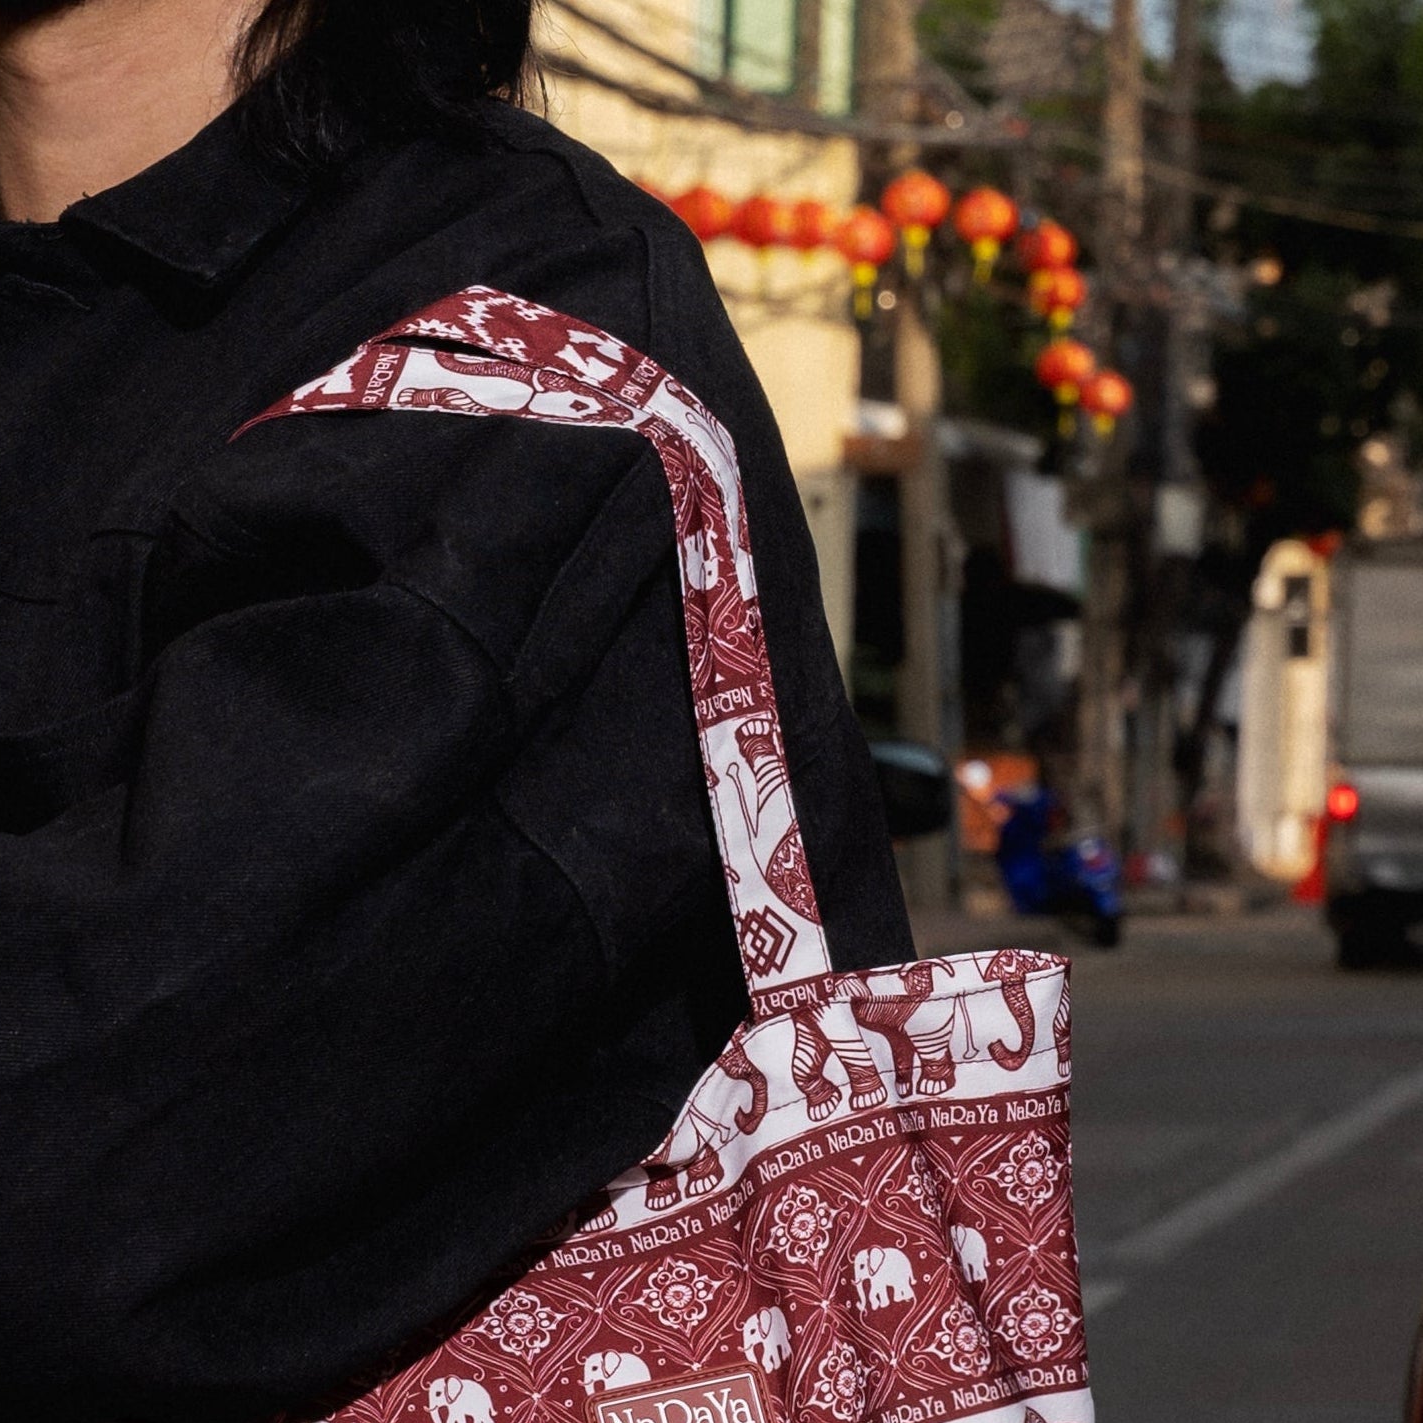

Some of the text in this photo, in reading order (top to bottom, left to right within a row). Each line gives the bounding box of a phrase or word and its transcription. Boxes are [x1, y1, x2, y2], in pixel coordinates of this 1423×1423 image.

[362, 353, 400, 404] NaRaYa
[551, 1240, 624, 1268] NaRaYa
[629, 1217, 703, 1253] NaRaYa
[707, 1183, 755, 1226] NaRaYa
[757, 1141, 823, 1184] NaRaYa
[826, 1118, 895, 1153] NaRaYa
[931, 1105, 998, 1128] NaRaYa
[1007, 1095, 1061, 1122] NaRaYa
[951, 1377, 1011, 1410] NaRaYa
[1015, 1364, 1077, 1391] NaRaYa
